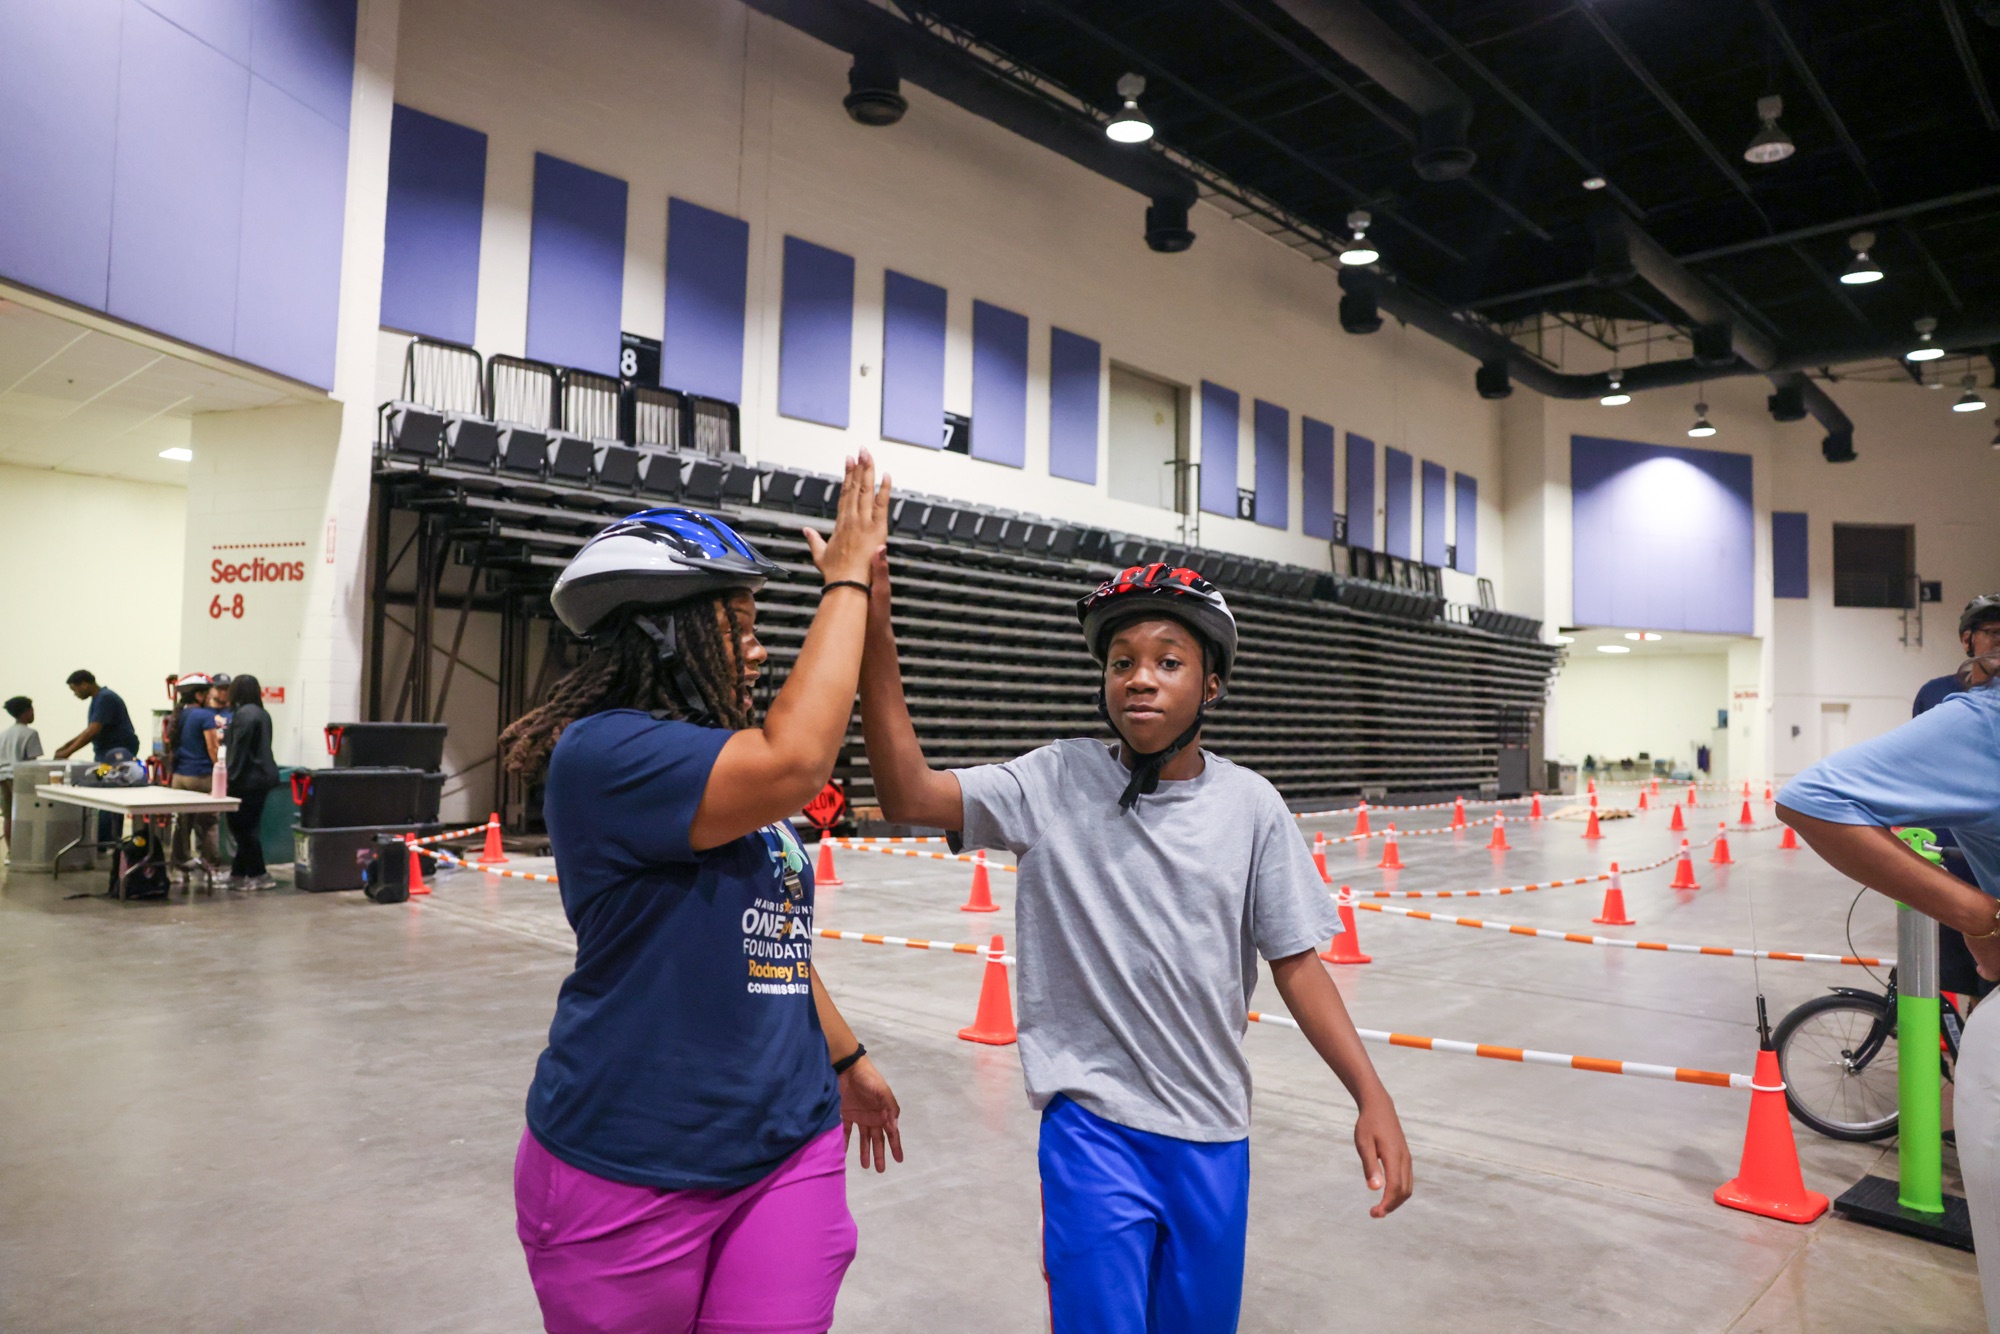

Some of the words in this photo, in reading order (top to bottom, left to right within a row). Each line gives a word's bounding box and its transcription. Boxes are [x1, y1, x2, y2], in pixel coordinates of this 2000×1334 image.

[620, 347, 638, 378] 8
[942, 423, 955, 448] 7
[210, 556, 305, 583] Sections
[209, 593, 245, 619] 6-8
[742, 908, 786, 939] ONE
[748, 959, 794, 983] Rodney
